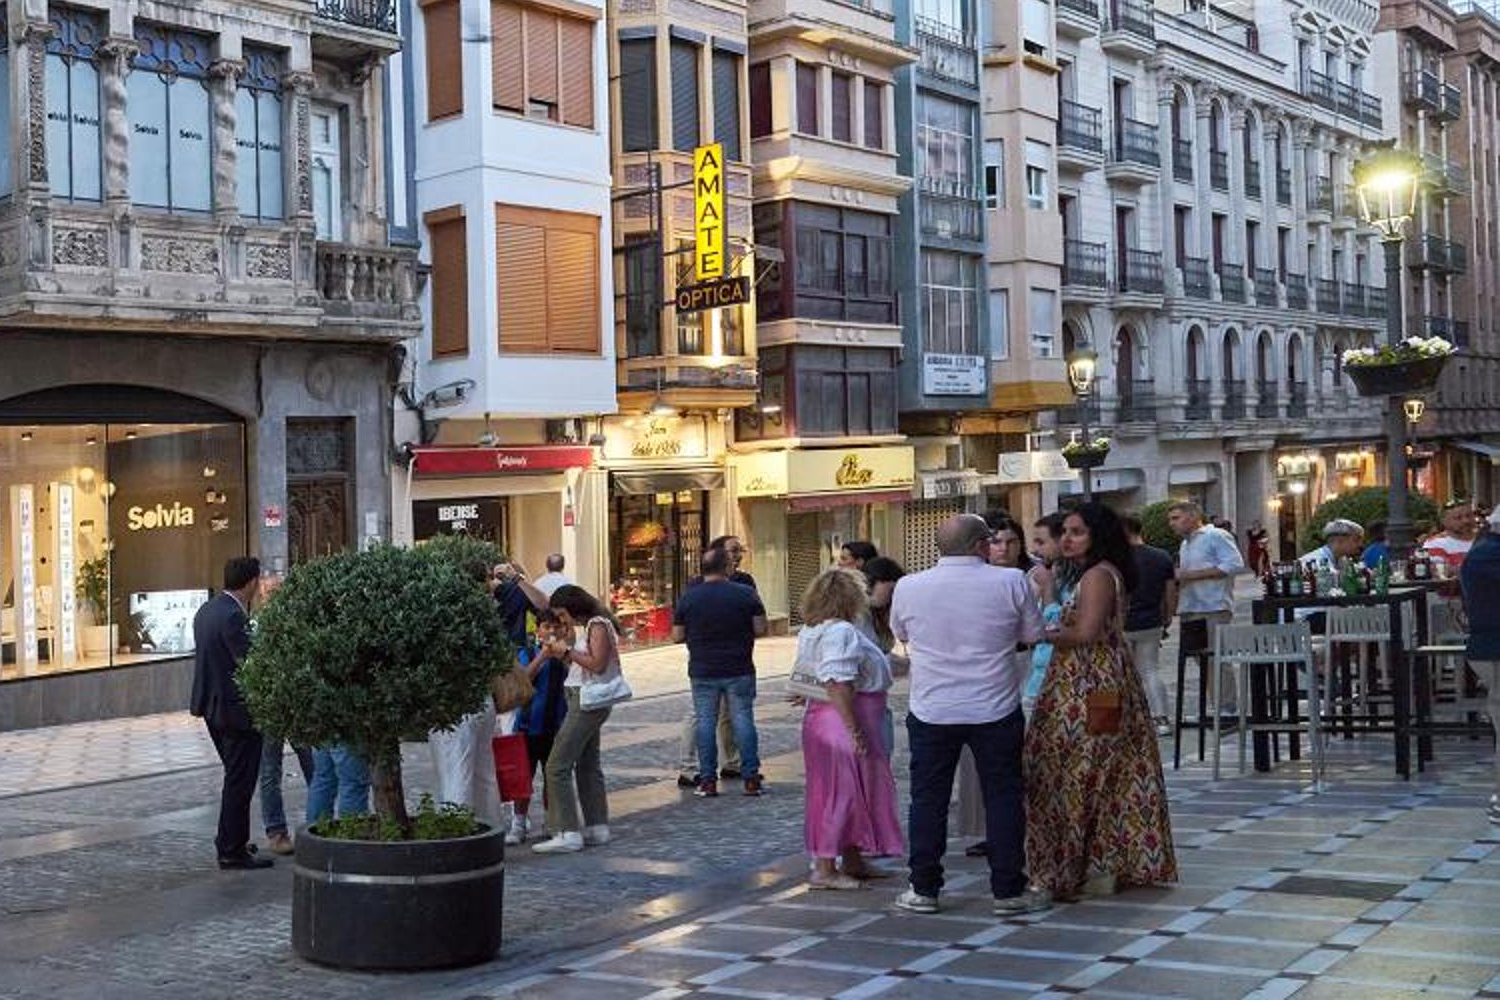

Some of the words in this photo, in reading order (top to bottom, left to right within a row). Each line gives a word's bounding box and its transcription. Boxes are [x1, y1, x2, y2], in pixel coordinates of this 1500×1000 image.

[697, 149, 720, 275] AMATE
[679, 282, 744, 310] OPTICA
[127, 501, 194, 531] Solvia
[438, 503, 479, 521] IBENSE
